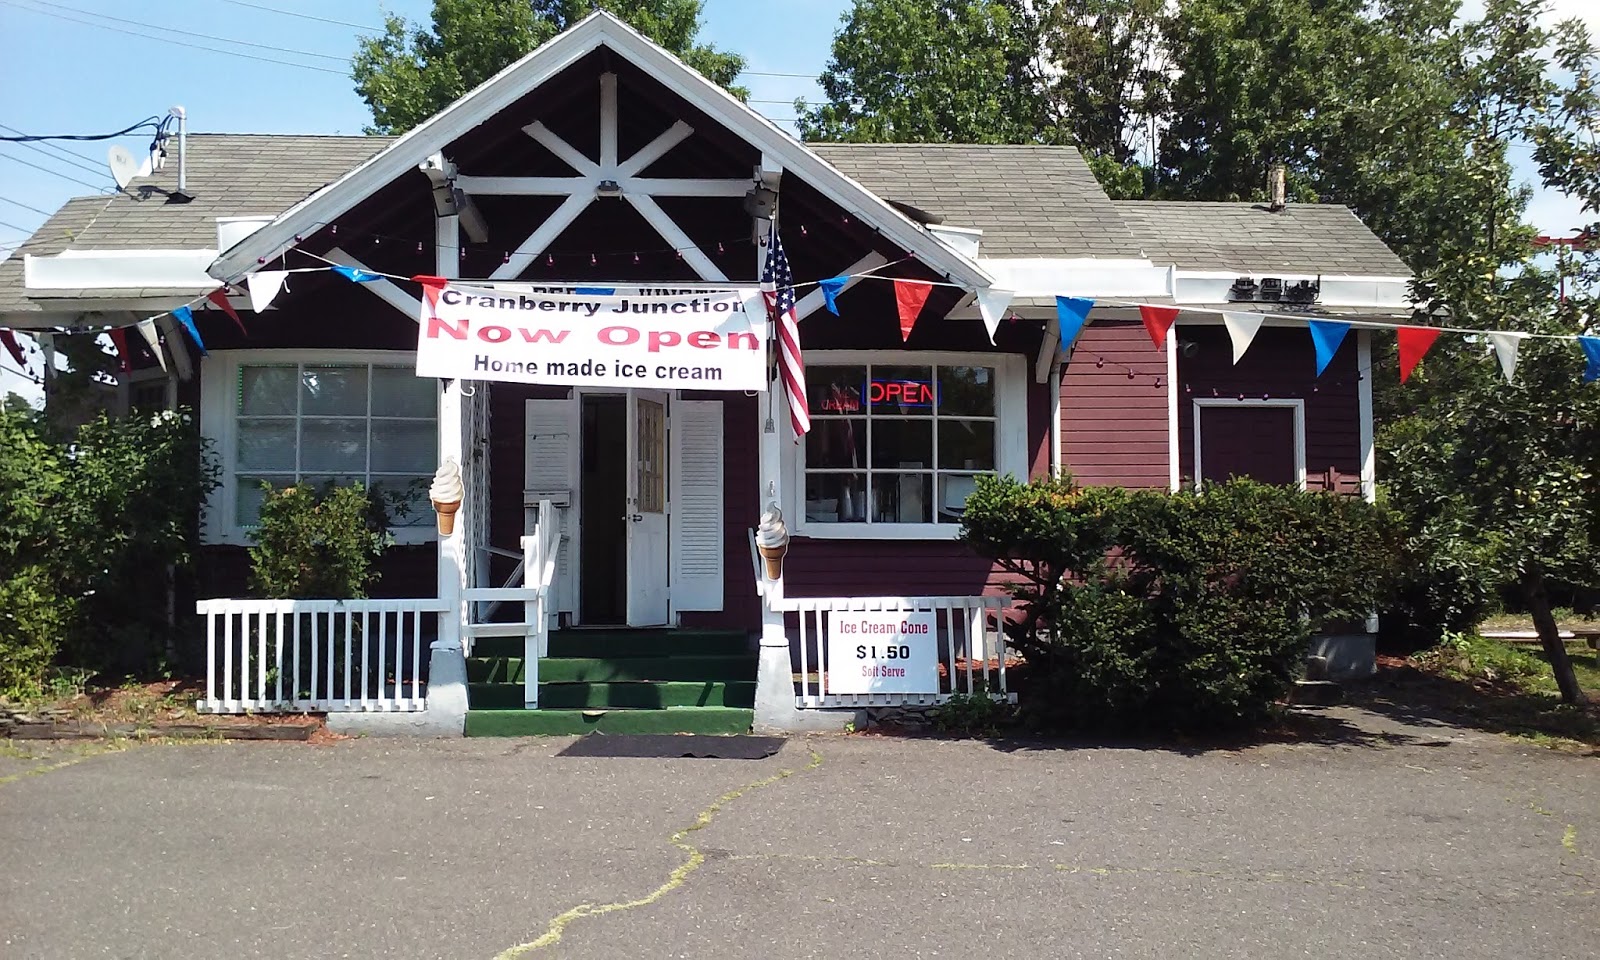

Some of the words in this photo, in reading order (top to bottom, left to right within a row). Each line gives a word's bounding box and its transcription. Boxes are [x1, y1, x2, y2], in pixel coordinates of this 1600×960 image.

[442, 290, 601, 317] Cranberry
[612, 298, 745, 314] Junction
[427, 318, 571, 343] Now
[597, 326, 759, 352] Open
[474, 354, 538, 374] Home
[546, 359, 606, 377] made
[615, 359, 647, 378] ice
[655, 365, 722, 381] cream
[870, 382, 934, 403] OPEN
[840, 620, 857, 634] Ice
[861, 620, 897, 634] Cream
[901, 620, 928, 634] Cone
[856, 645, 910, 659] $1.50
[881, 665, 905, 677] Serve
